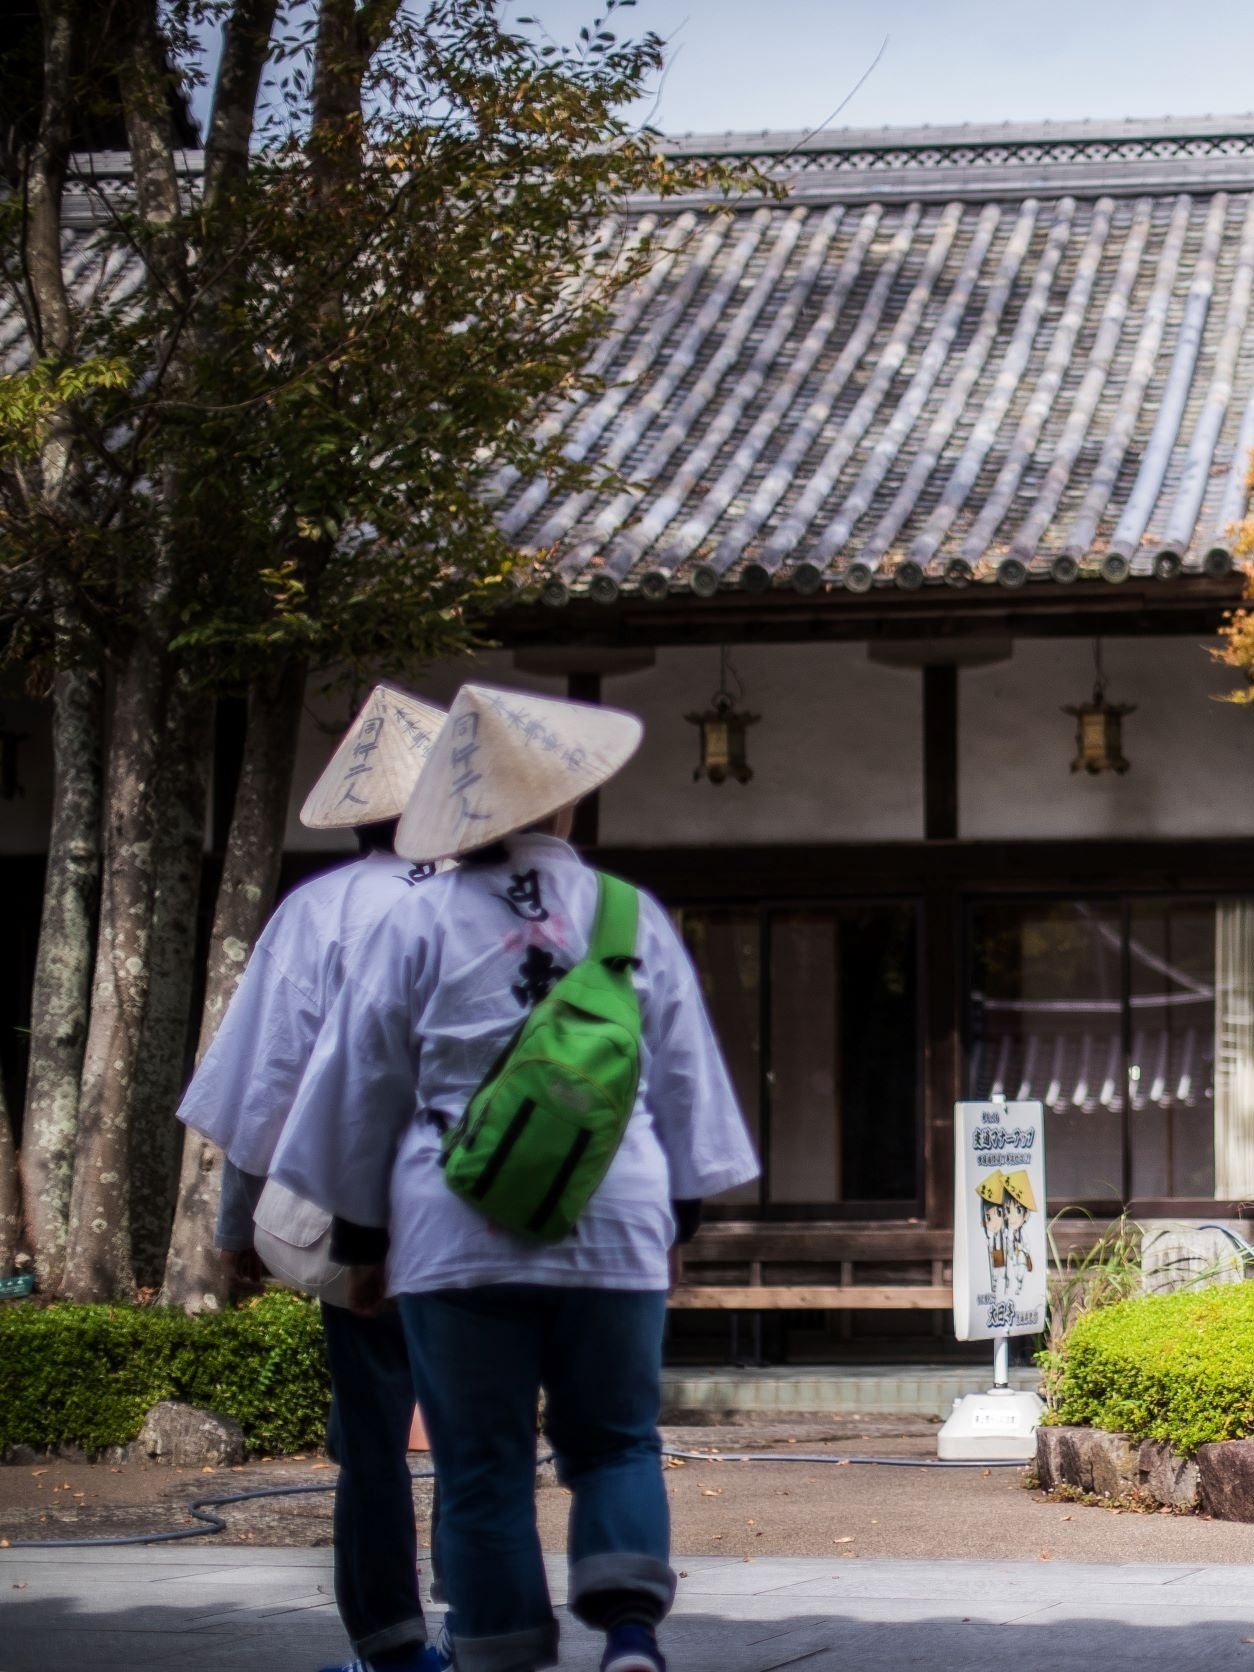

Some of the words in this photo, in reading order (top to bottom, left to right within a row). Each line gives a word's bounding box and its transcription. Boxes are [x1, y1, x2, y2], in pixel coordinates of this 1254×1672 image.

[335, 717, 384, 810] 同行二人
[449, 711, 492, 838] 同行二人
[987, 1299, 1015, 1328] 大日寺
